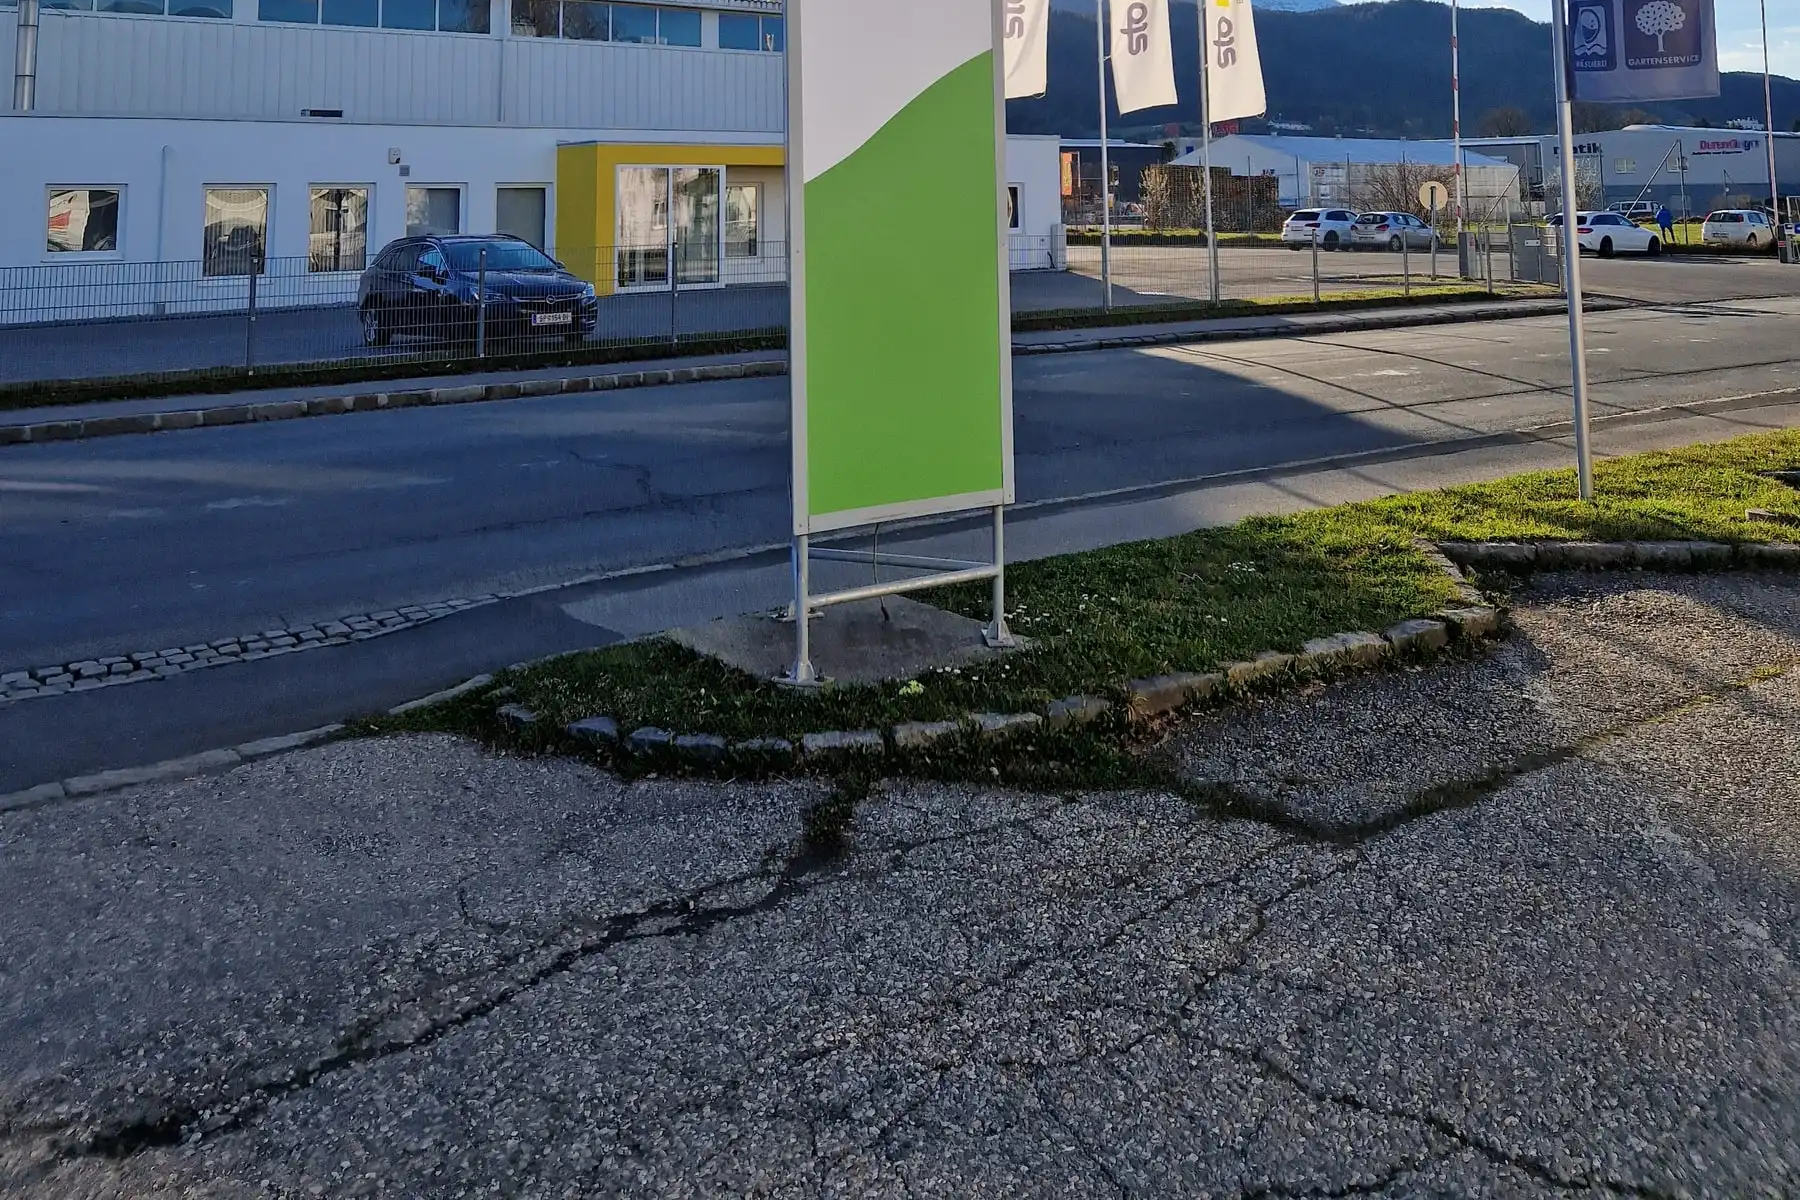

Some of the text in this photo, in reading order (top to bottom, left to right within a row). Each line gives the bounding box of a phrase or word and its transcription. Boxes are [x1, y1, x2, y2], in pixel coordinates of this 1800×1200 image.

[1120, 1, 1148, 56] sto
[1212, 15, 1237, 69] sto
[1628, 54, 1699, 67] GARTENSERVICE
